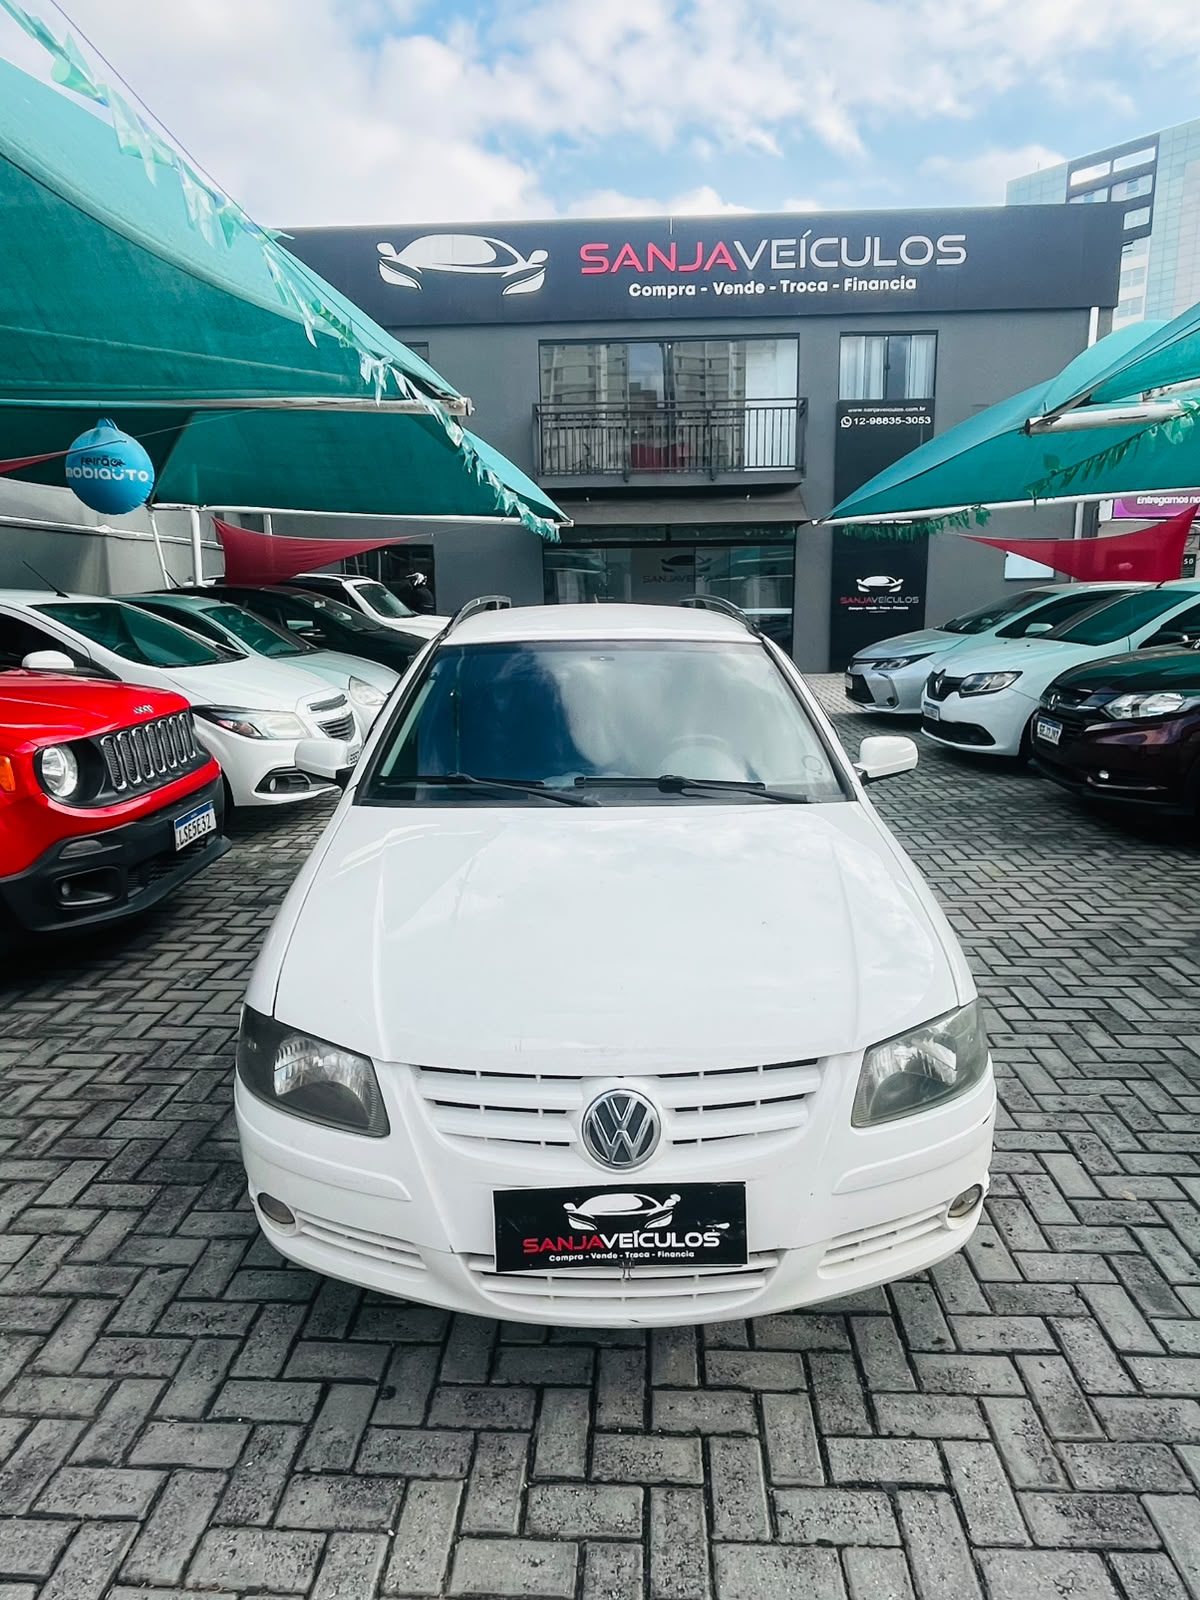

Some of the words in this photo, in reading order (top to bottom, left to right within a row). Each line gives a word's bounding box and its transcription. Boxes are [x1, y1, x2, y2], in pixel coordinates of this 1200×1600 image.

[579, 229, 968, 274] SANJAVEÍCULOS
[628, 283, 696, 299] Compra
[712, 280, 765, 296] Vende
[779, 278, 828, 293] Troca
[843, 275, 917, 292] Financia
[853, 416, 932, 426] 12-98835-3053
[1136, 495, 1189, 507] Entregamos
[179, 813, 211, 846] LSE5E32
[522, 1230, 721, 1254] SANJAVEÍCULOS
[549, 1254, 584, 1262] Compra
[657, 1250, 695, 1258] Financia
